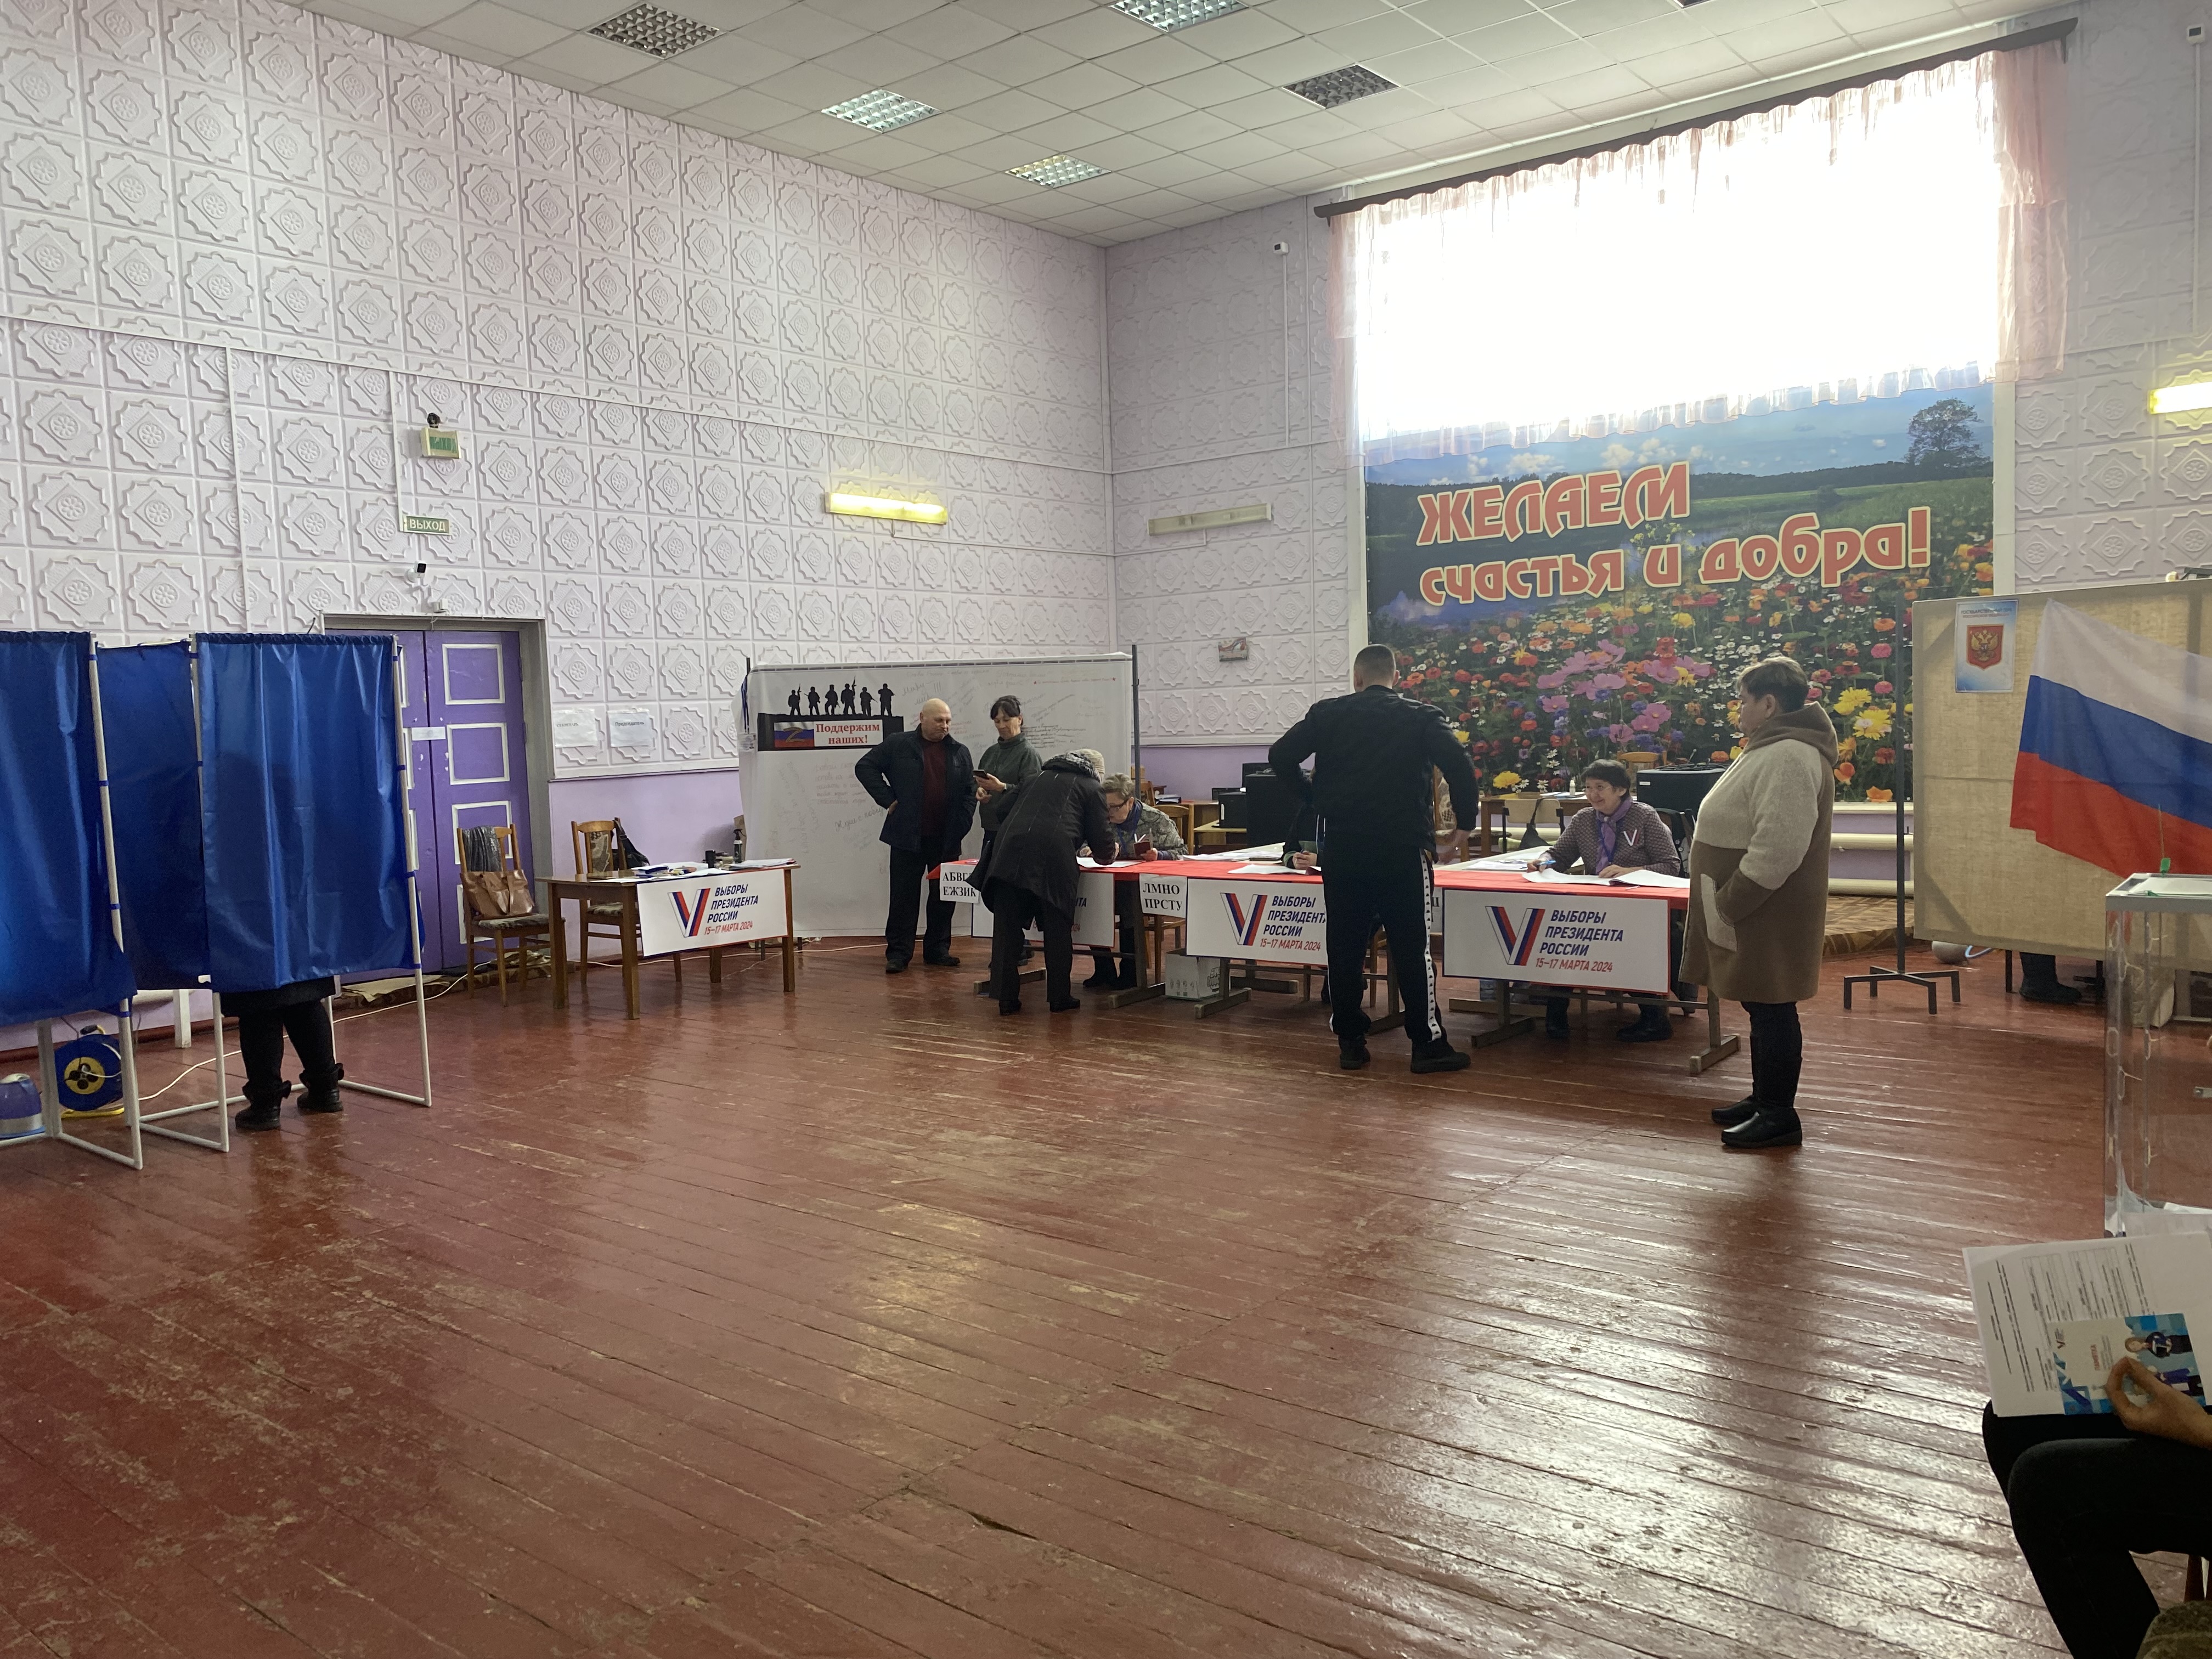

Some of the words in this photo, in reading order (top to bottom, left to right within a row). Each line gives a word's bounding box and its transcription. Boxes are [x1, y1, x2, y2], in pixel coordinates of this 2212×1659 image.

[1416, 461, 1690, 546] ЖЕЛАЕМ
[409, 518, 445, 532] ВЫХОД
[1419, 549, 1624, 606] счастья
[1643, 543, 1681, 588] и
[1698, 506, 1931, 588] добра!
[816, 724, 879, 733] Поддержим
[828, 735, 868, 744] наших!
[942, 872, 972, 882] АБВГ
[714, 883, 748, 896] ВЫБОРЫ
[943, 886, 976, 897] ЕЖЗИК
[1143, 883, 1180, 895] ЛМНО
[710, 895, 758, 910] ПРЕЗИДЕНТА
[1144, 898, 1183, 911] ПРСТУ
[1272, 895, 1316, 908] ВЫБОРЫ
[707, 911, 738, 923] РОССИИ
[1550, 910, 1607, 924] ВЫБОРЫ
[721, 923, 739, 933] МАРТА
[740, 921, 753, 930] 2024
[1263, 924, 1303, 936] РОССИИ
[1545, 926, 1623, 942] ПРЕЗИДЕНТА
[1278, 939, 1303, 950] МАРТА
[1304, 941, 1321, 951] 2024
[1539, 942, 1590, 956] РОССИИ
[1559, 959, 1590, 971] МАРТА
[1591, 961, 1613, 972] 2024
